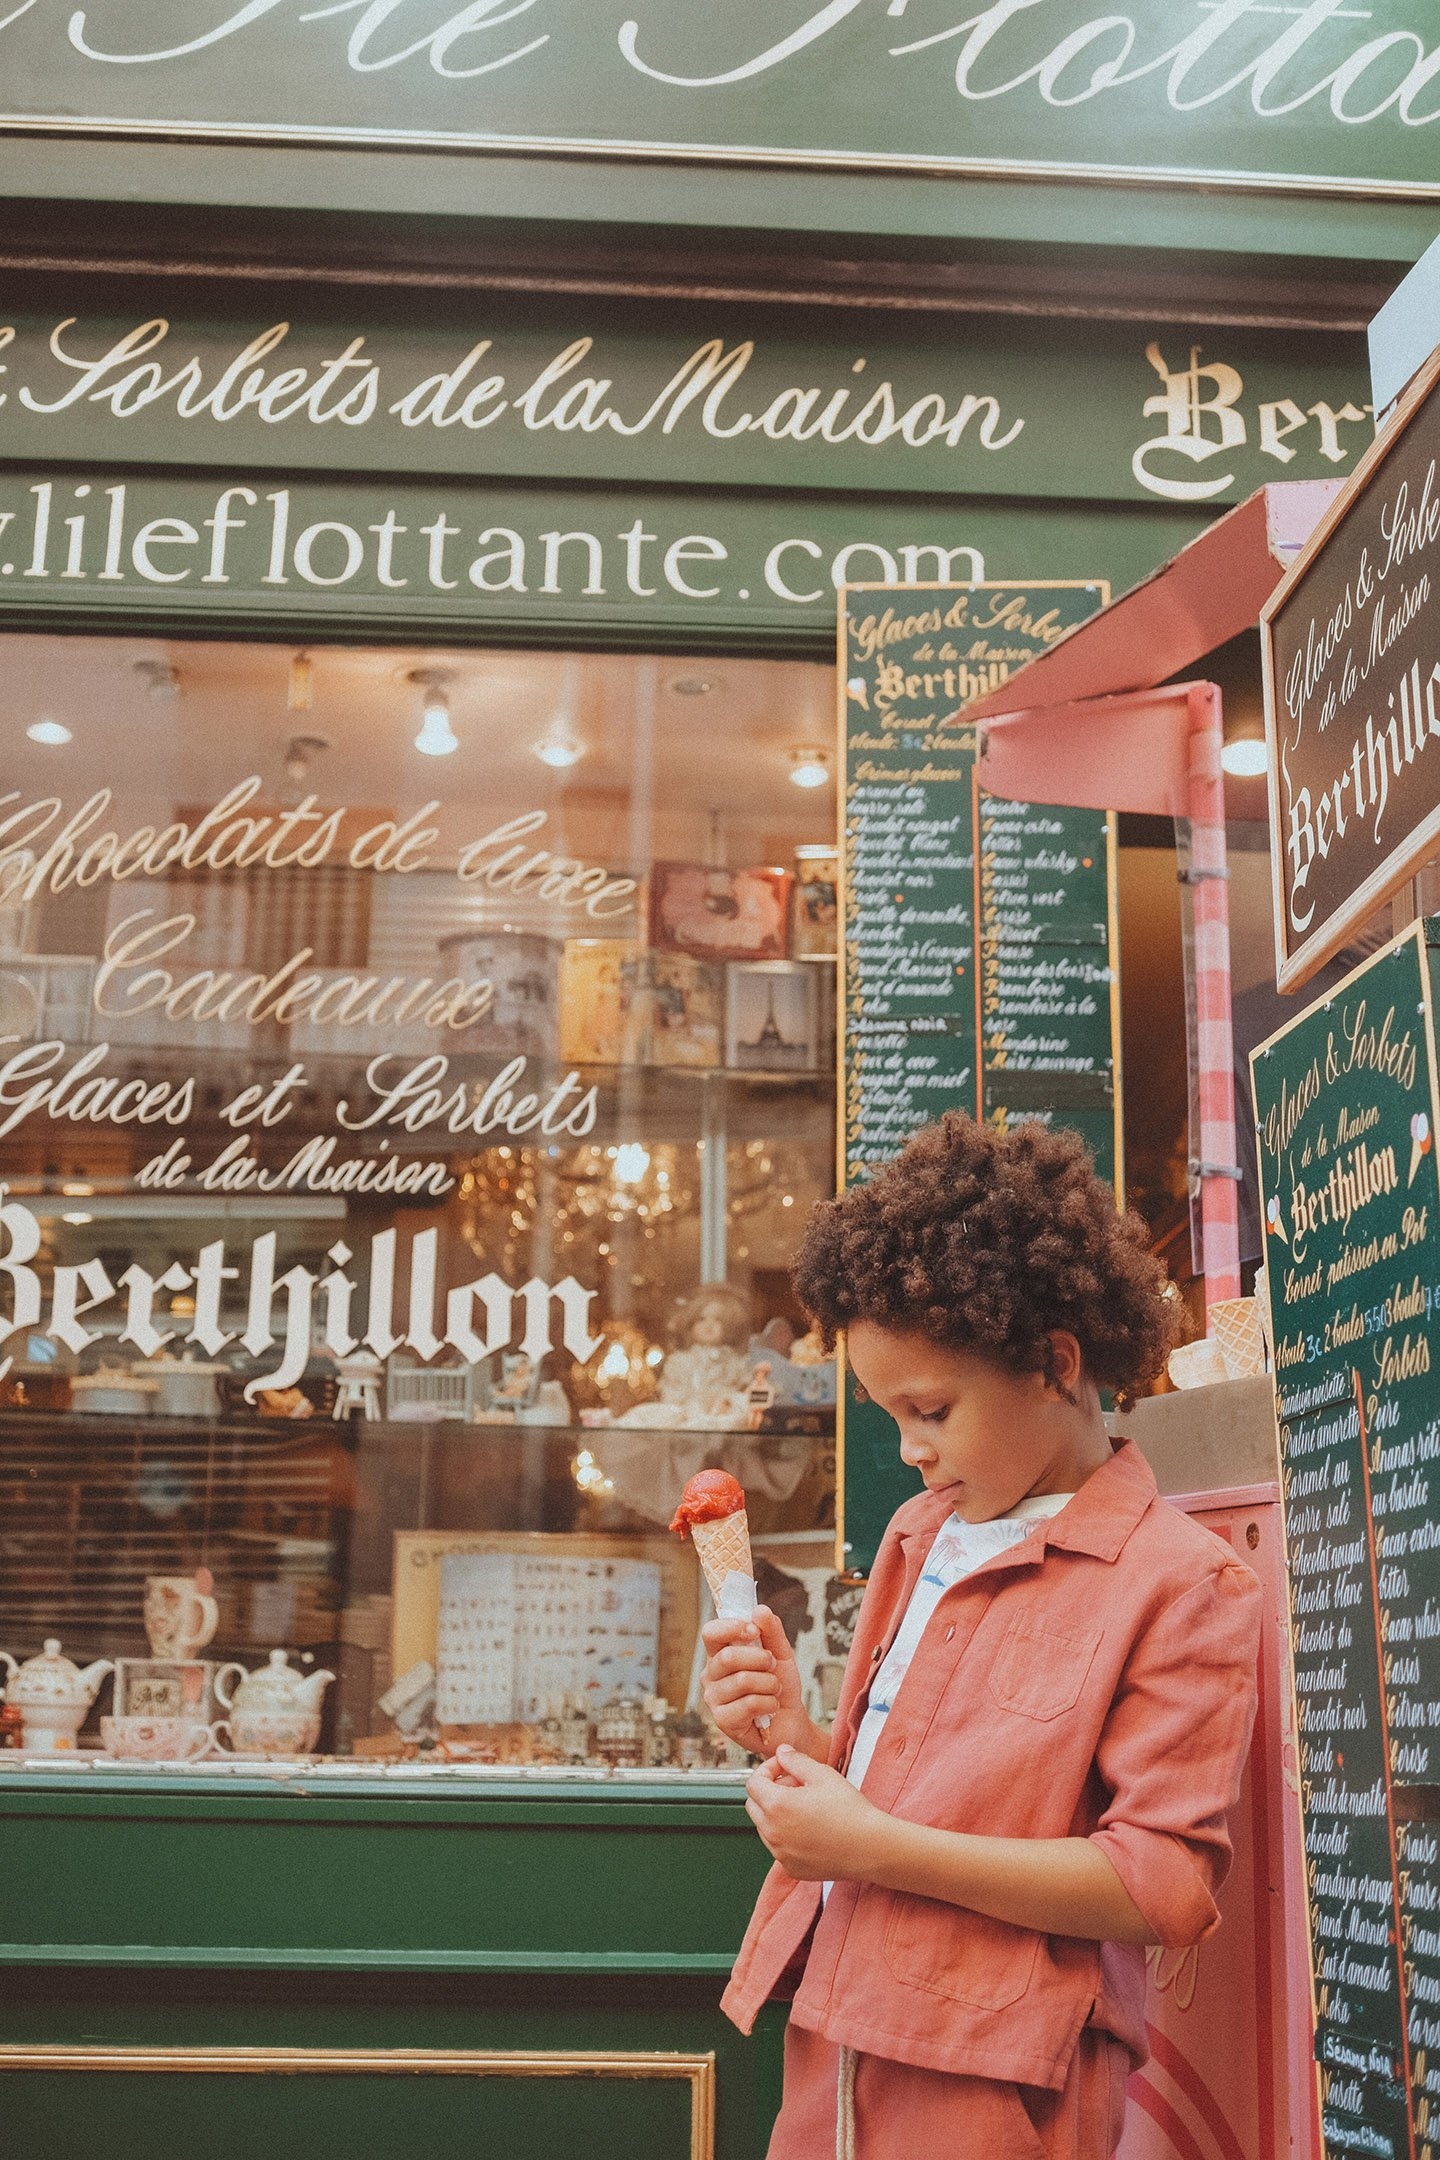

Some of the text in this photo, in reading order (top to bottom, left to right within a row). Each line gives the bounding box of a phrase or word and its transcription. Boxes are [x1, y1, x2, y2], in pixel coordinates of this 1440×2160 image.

[19, 317, 381, 426] Sorbets
[389, 339, 510, 430] de
[513, 336, 614, 433] la
[606, 336, 1025, 451] Maison
[1131, 340, 1375, 500] Ber
[0, 482, 985, 603] .lileflottante.com
[848, 591, 1079, 663] Glaces & Sorbe
[1285, 459, 1440, 752] Glaces & Sorbe
[1318, 573, 1431, 733] de la Maison
[873, 652, 1009, 710] Berthill
[0, 775, 639, 919] Chocolats de luxe
[94, 907, 493, 1030] Cadeaux
[0, 1035, 599, 1137] Glaces et Sorbets
[1265, 999, 1416, 1189] Glaces & Sorbets
[1301, 1102, 1381, 1169] de la Maison
[133, 1134, 456, 1196] de la Maison
[1290, 1141, 1399, 1264] Berthillon
[1284, 1258, 1323, 1305] Cornet
[1400, 1205, 1428, 1251] Pot
[1372, 1331, 1430, 1390] Sorbets
[1364, 1390, 1401, 1434] Poire
[1282, 1453, 1351, 1501] Caramel au
[1368, 1435, 1416, 1475] Ananas
[1286, 1487, 1351, 1538] beurre salé
[1372, 1467, 1429, 1517] au basilic
[1290, 1530, 1366, 1576] Chocolat nougat
[1374, 1525, 1408, 1559] Cacao
[1290, 1571, 1363, 1615] Chocolat blanc
[1379, 1563, 1410, 1600] bitter
[1292, 1616, 1353, 1654] Chocolat du
[1380, 1606, 1414, 1642] Cacao
[1296, 1655, 1348, 1693] mendiant
[1383, 1646, 1420, 1685] Cassis
[1297, 1693, 1368, 1732] Chocolat noir
[1386, 1690, 1427, 1728] Citron
[1389, 1732, 1429, 1774] Cerise
[1302, 1777, 1387, 1817] Feuille de menthe
[1305, 1817, 1350, 1855] chocolat
[1395, 1822, 1438, 1865] Fraise
[1358, 1873, 1394, 1919] orange
[1310, 1902, 1391, 1948] Grand Marnier
[1314, 1942, 1339, 1980] Lait
[1403, 1960, 1440, 2003] Fram
[1316, 1984, 1351, 2024] Moka
